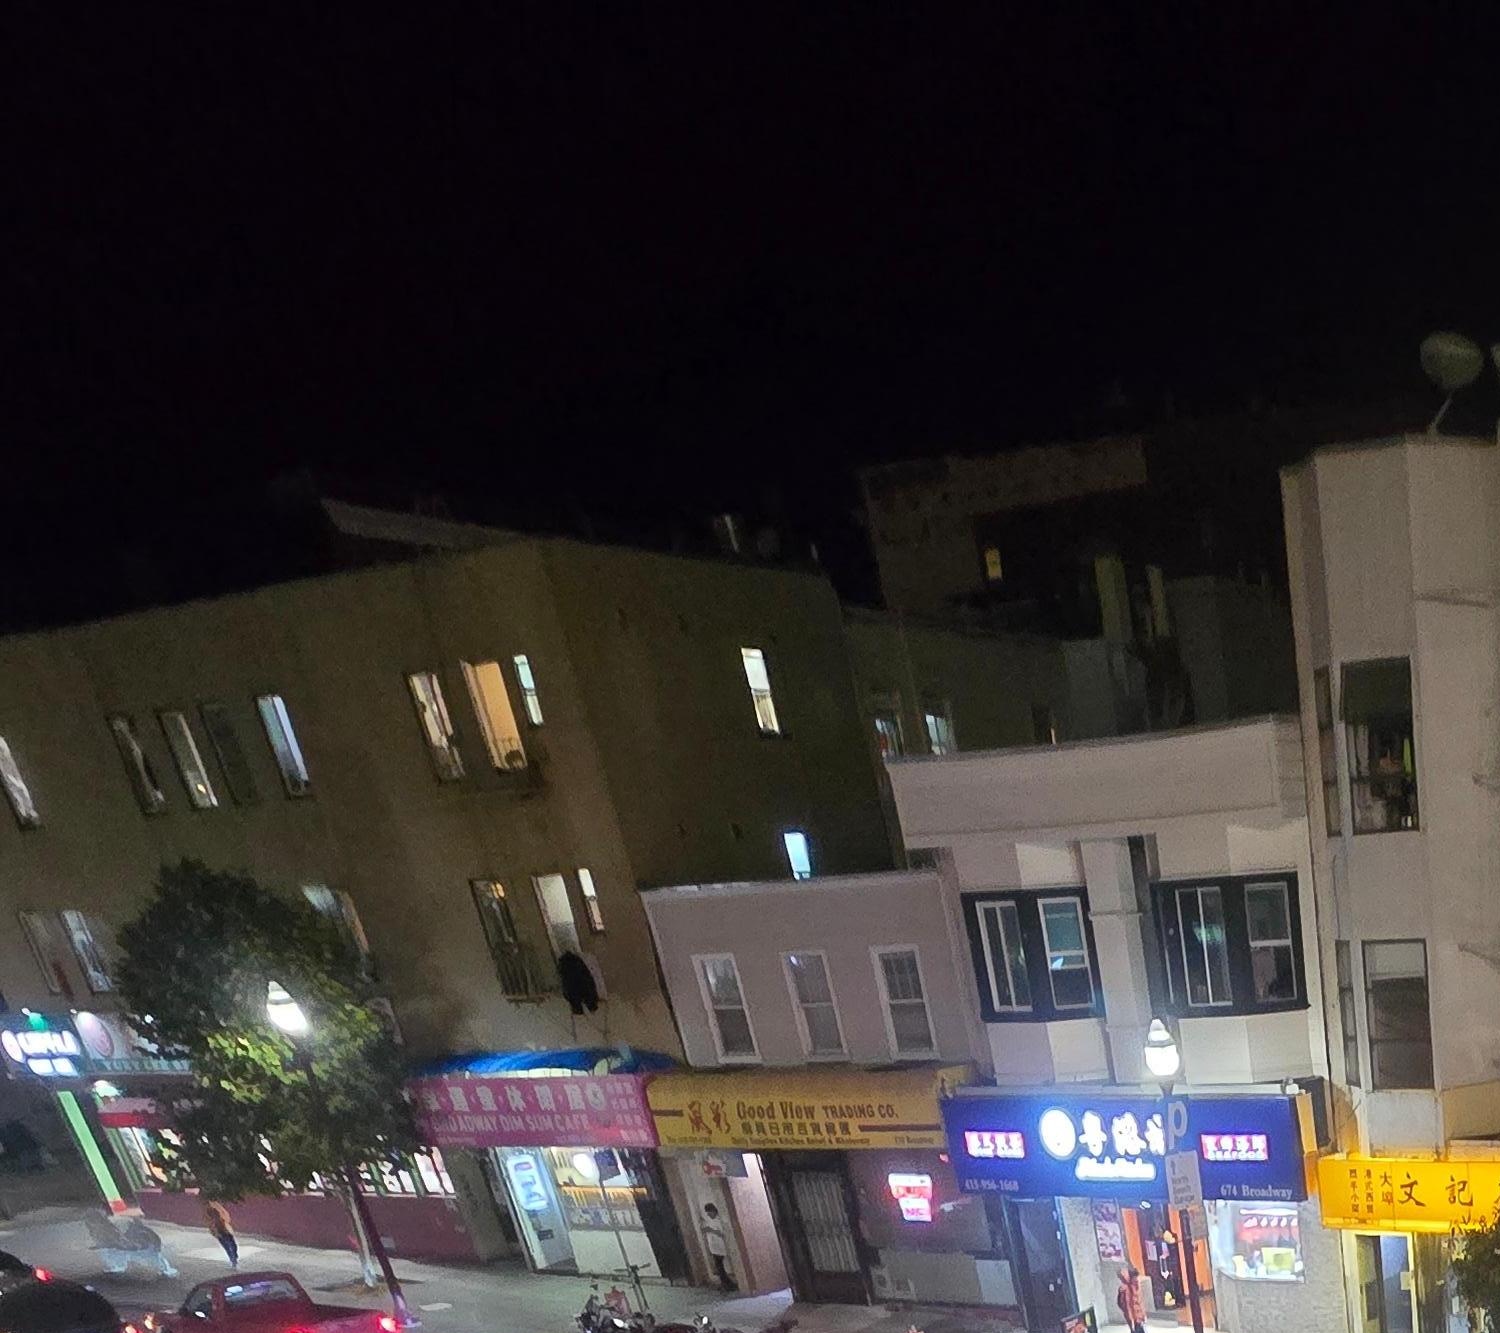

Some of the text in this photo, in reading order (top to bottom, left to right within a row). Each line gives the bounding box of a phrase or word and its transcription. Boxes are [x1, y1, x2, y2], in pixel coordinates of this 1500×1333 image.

[736, 1100, 776, 1120] Good
[780, 1101, 815, 1120] View
[822, 1104, 875, 1119] TRADING
[1168, 1101, 1188, 1150] P
[1220, 1184, 1293, 1200] 674 Broadway
